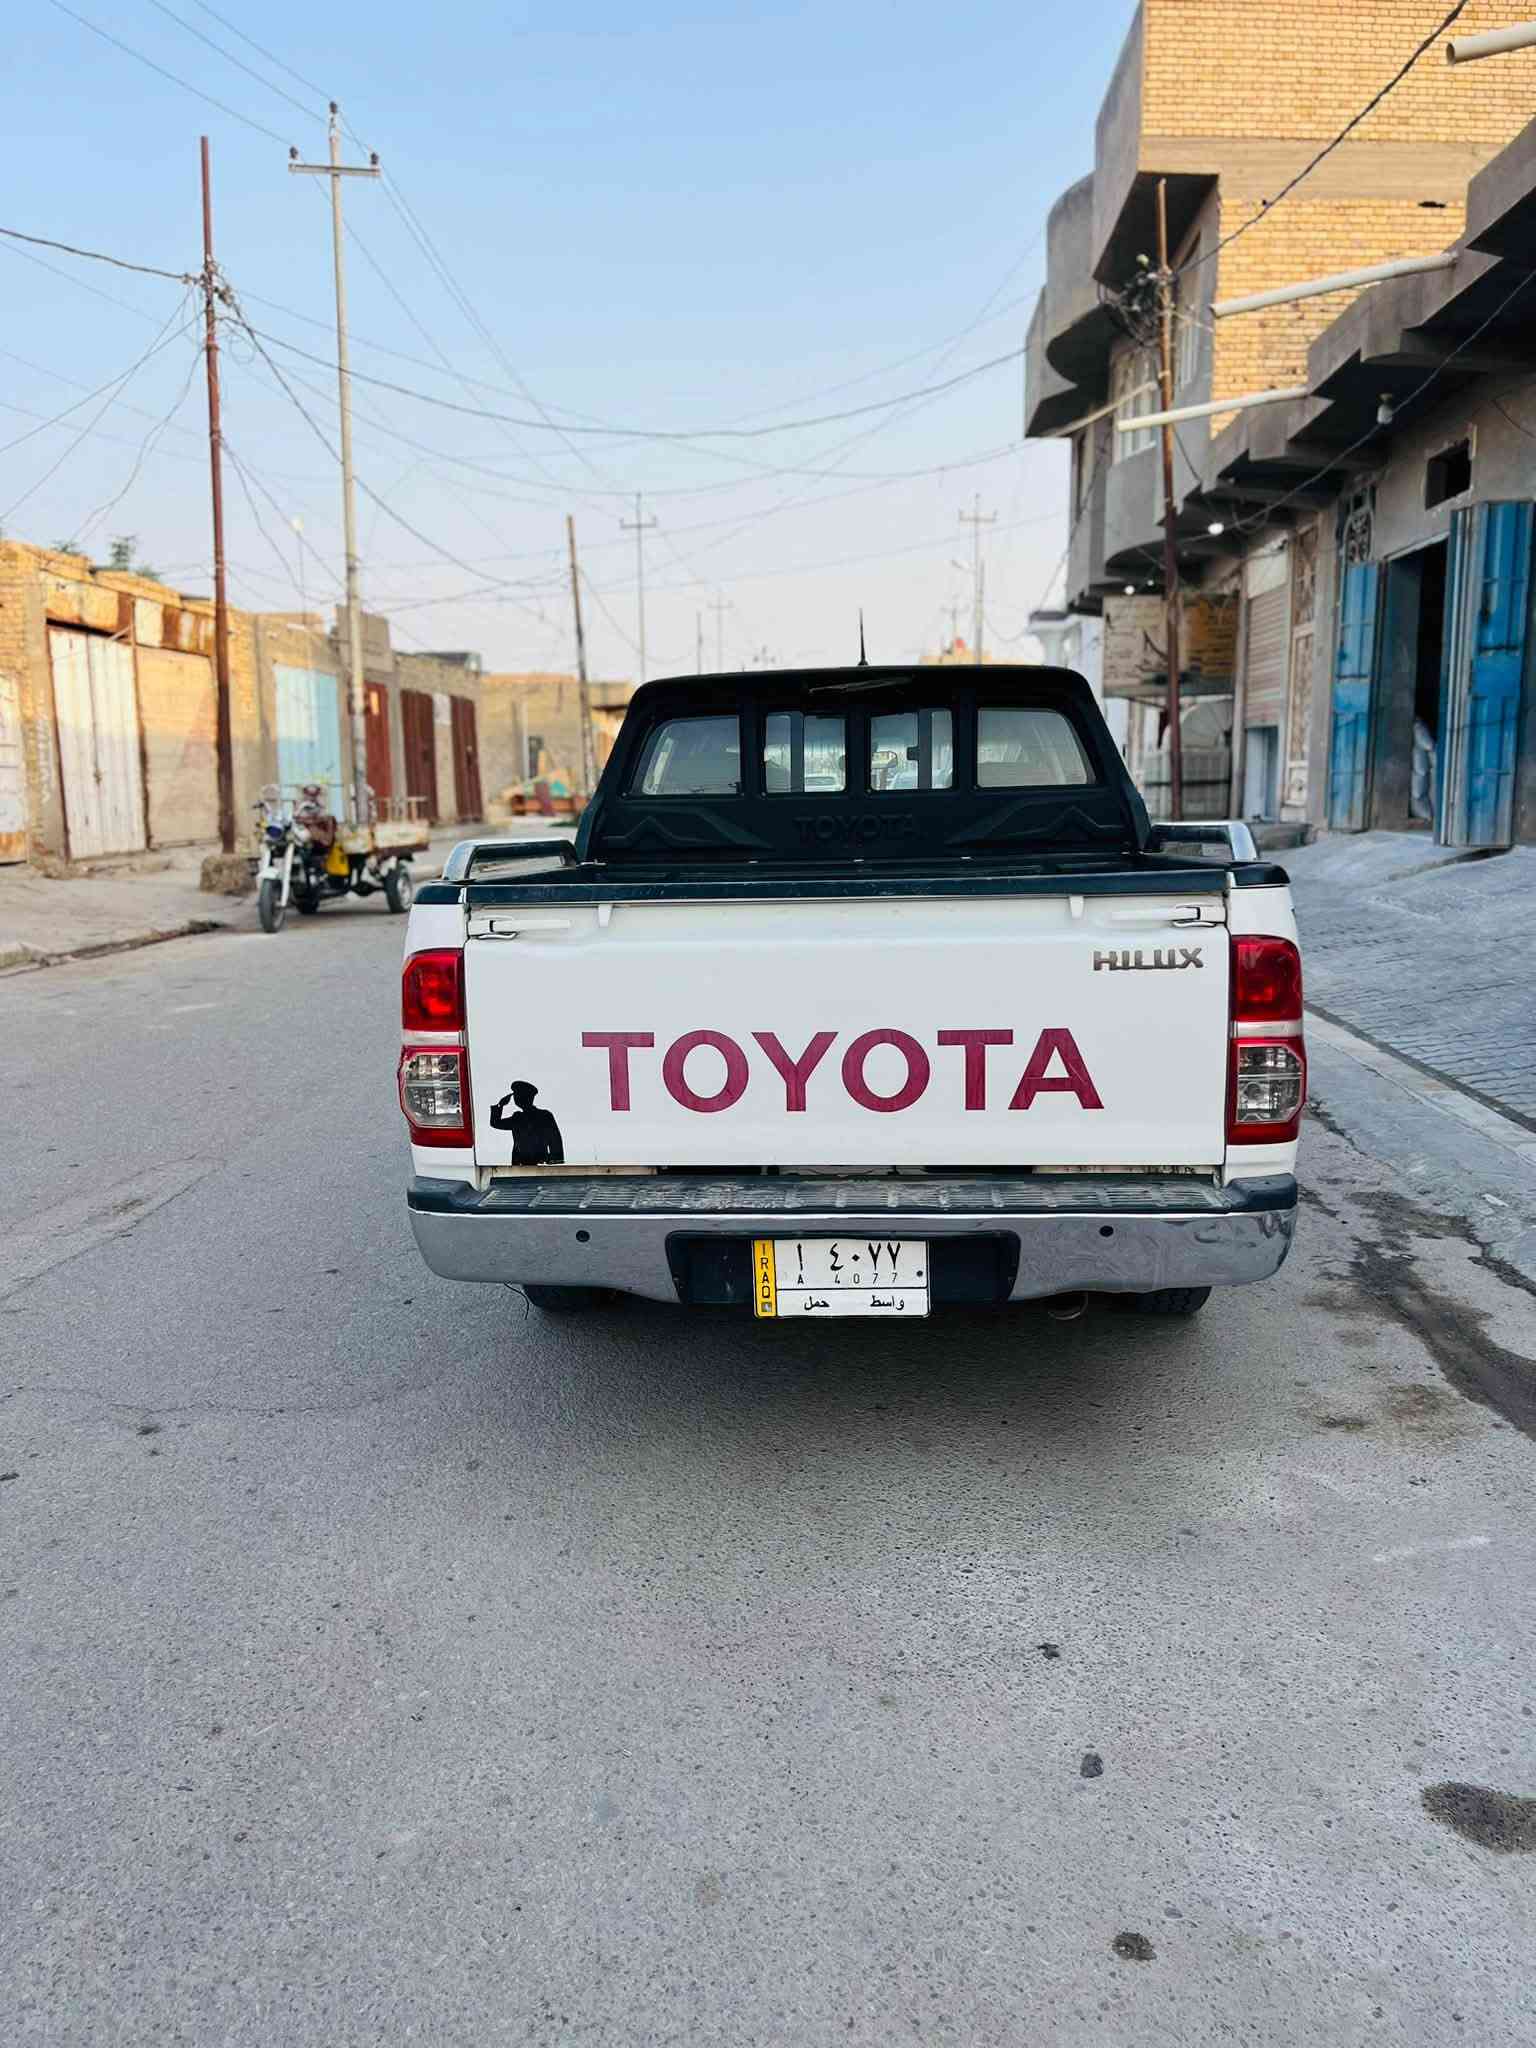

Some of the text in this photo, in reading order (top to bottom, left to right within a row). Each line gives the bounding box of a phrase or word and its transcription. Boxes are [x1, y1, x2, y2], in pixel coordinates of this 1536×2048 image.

[793, 815, 918, 843] TOYOTA
[1093, 948, 1203, 971] HILUX
[582, 1028, 1105, 1113] TOYOTA
[804, 1295, 905, 1311] واسط حمل
